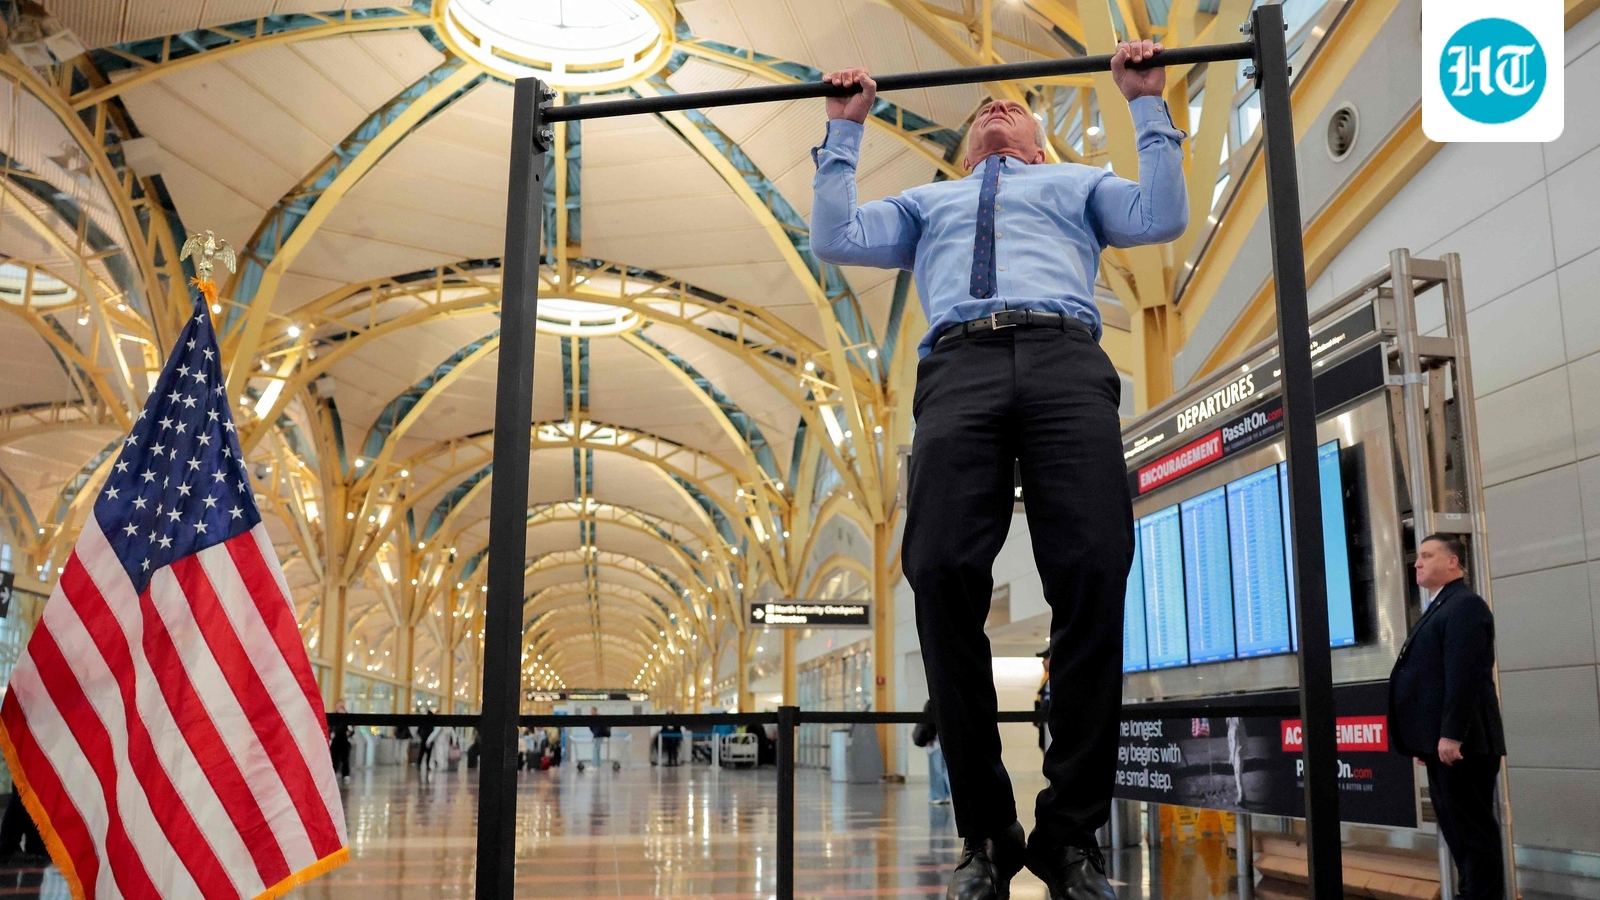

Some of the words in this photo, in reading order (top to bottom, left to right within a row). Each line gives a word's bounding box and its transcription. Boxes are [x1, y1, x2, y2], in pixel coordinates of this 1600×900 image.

[1176, 374, 1255, 433] DEPARTURES
[1222, 408, 1283, 444] PassItOn.com
[1140, 436, 1220, 488] ENCOURAGEMENT
[1130, 719, 1163, 741] longest
[1285, 723, 1383, 745] ACEMENT
[1130, 742, 1160, 767] begins
[1160, 742, 1181, 763] with
[1126, 768, 1149, 788] small
[1149, 769, 1173, 793] step.
